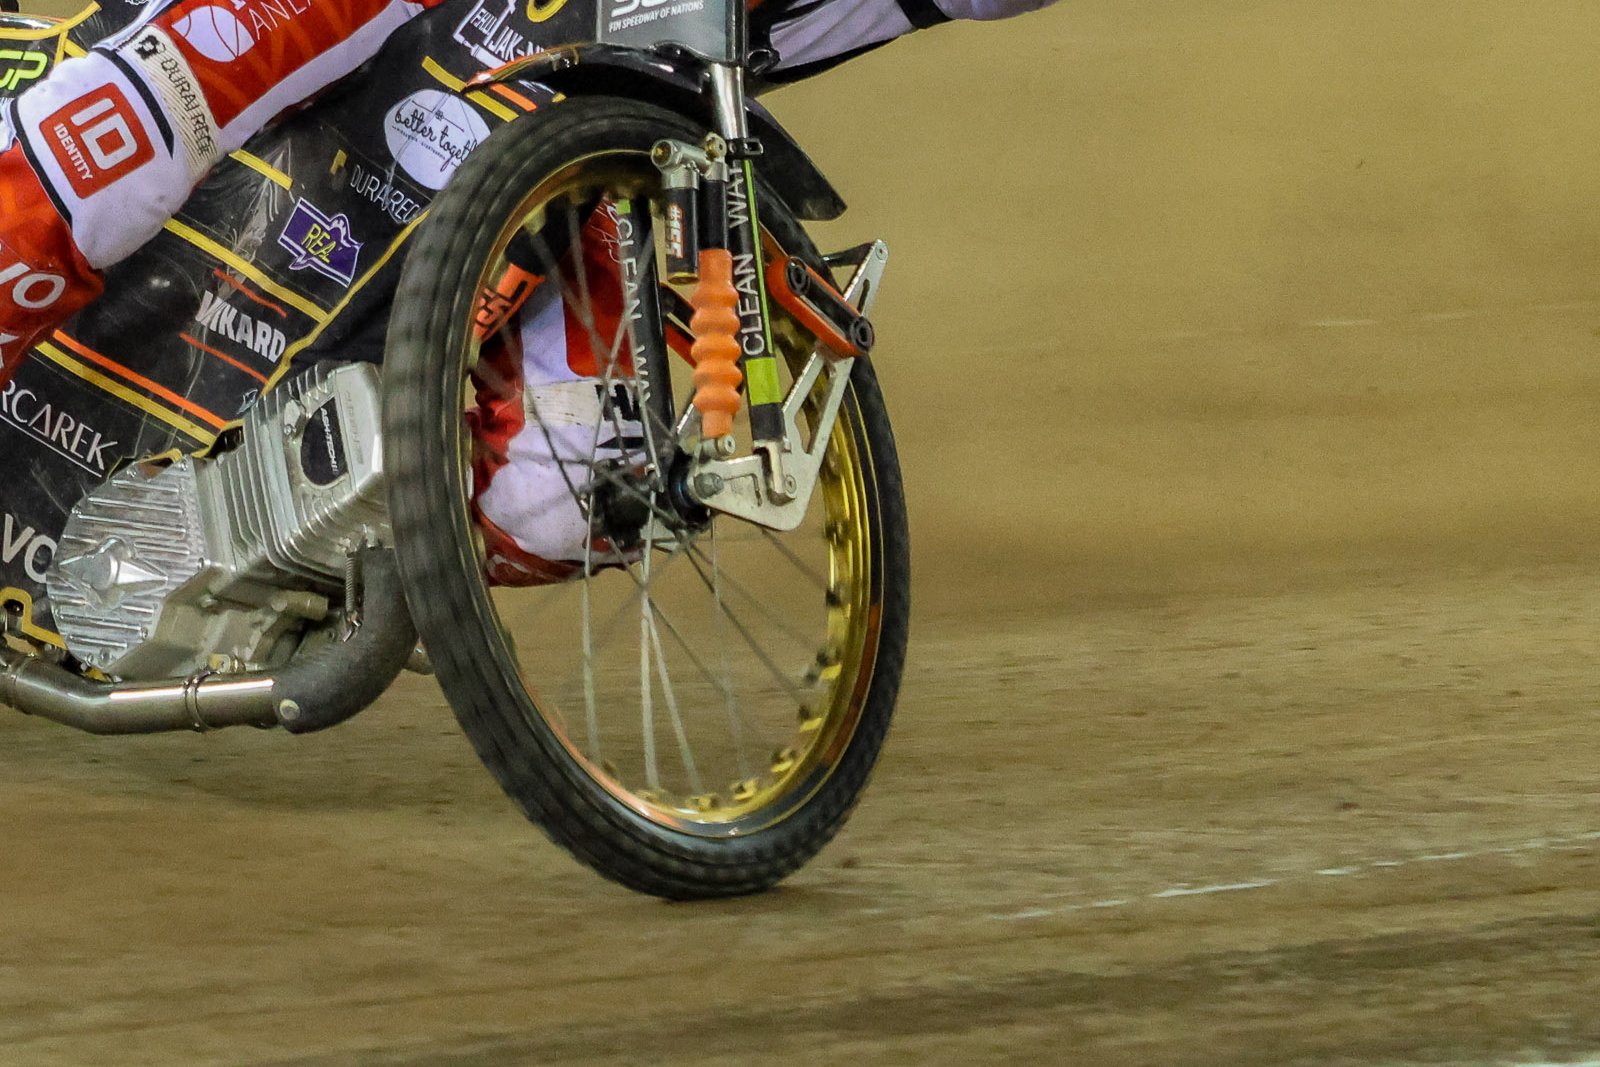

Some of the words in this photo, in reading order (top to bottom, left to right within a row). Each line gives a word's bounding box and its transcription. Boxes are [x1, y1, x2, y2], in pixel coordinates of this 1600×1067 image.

[608, 19, 622, 34] FIM
[621, 13, 660, 29] SPEEDWAY
[660, 7, 670, 20] OF
[670, 0, 704, 15] NATIONS
[394, 98, 439, 143] better
[53, 121, 95, 182] IDENTITY
[733, 253, 766, 357] CLEAN
